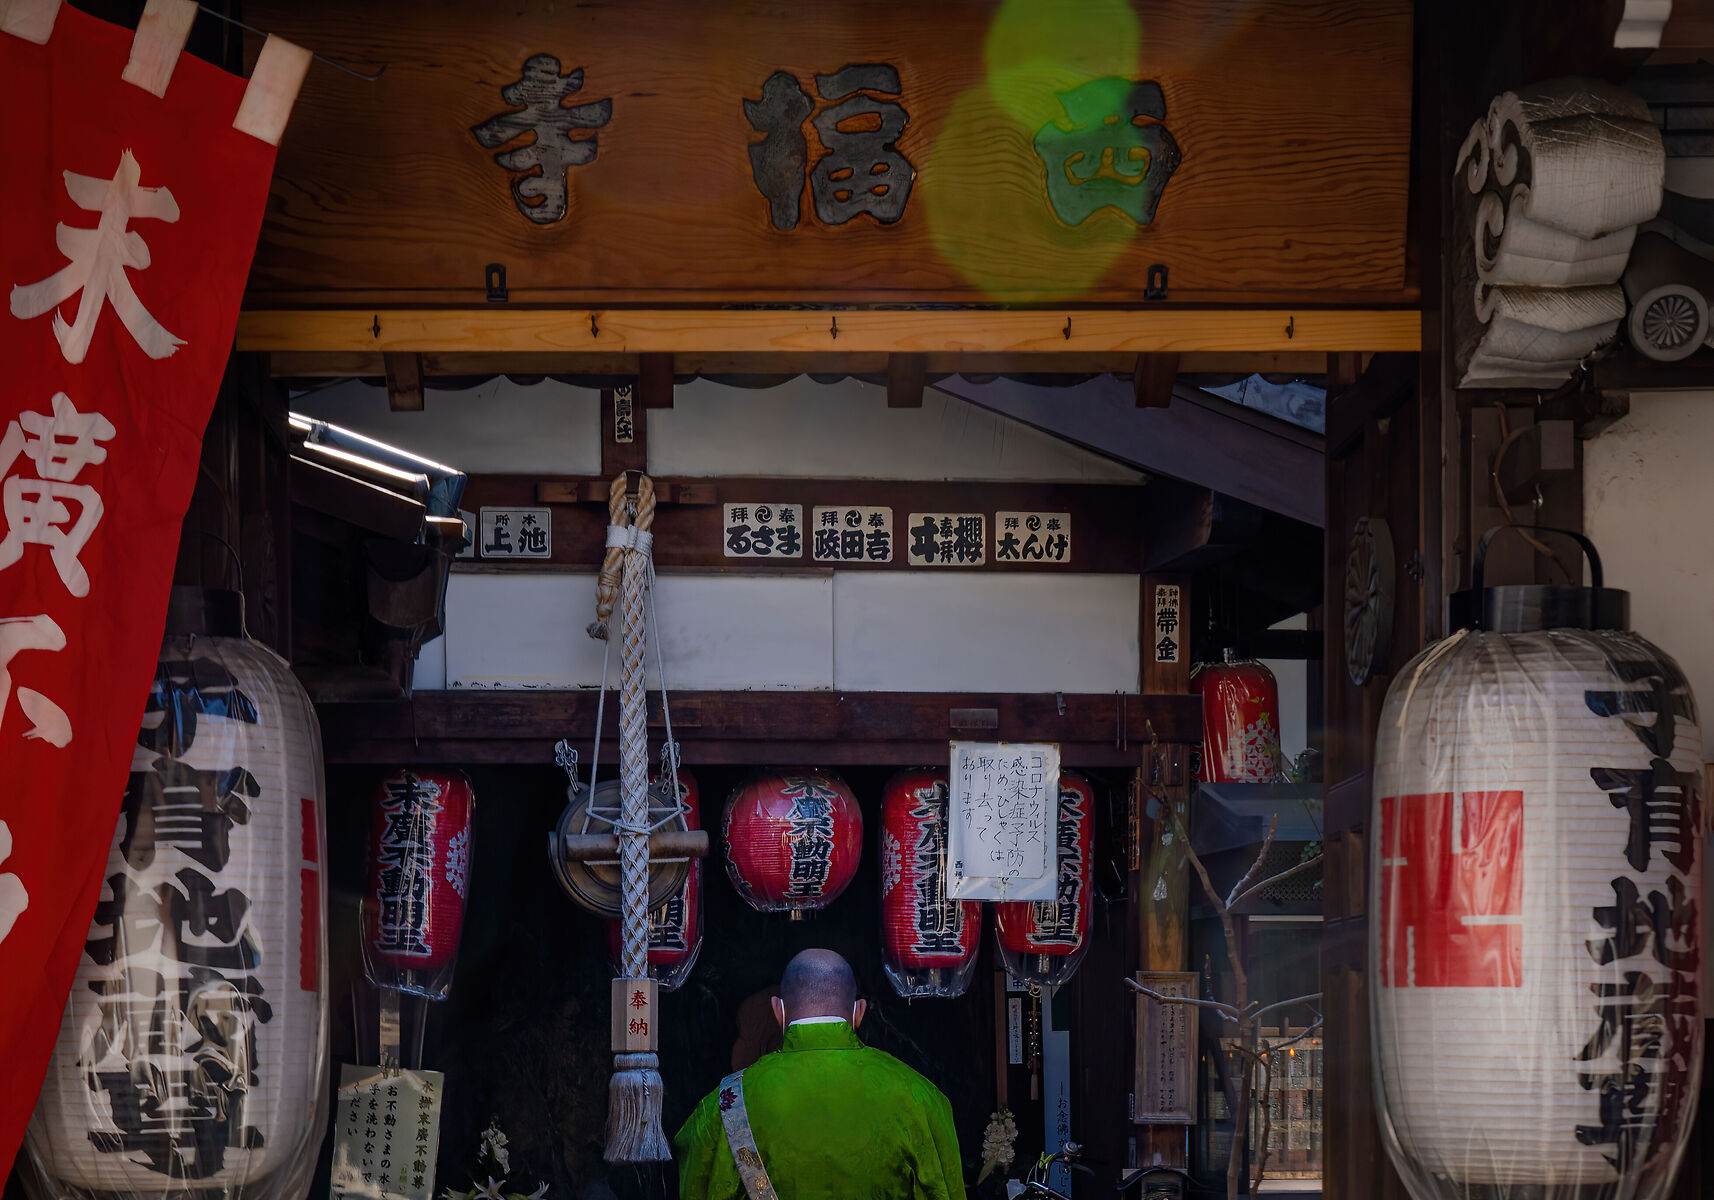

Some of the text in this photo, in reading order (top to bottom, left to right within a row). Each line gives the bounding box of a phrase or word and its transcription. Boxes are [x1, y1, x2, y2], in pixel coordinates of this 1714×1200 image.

[962, 756, 975, 829] おります
[975, 756, 995, 842] 取り去って
[1007, 756, 1029, 877] 感染症予防の
[629, 990, 648, 1036] 奉納
